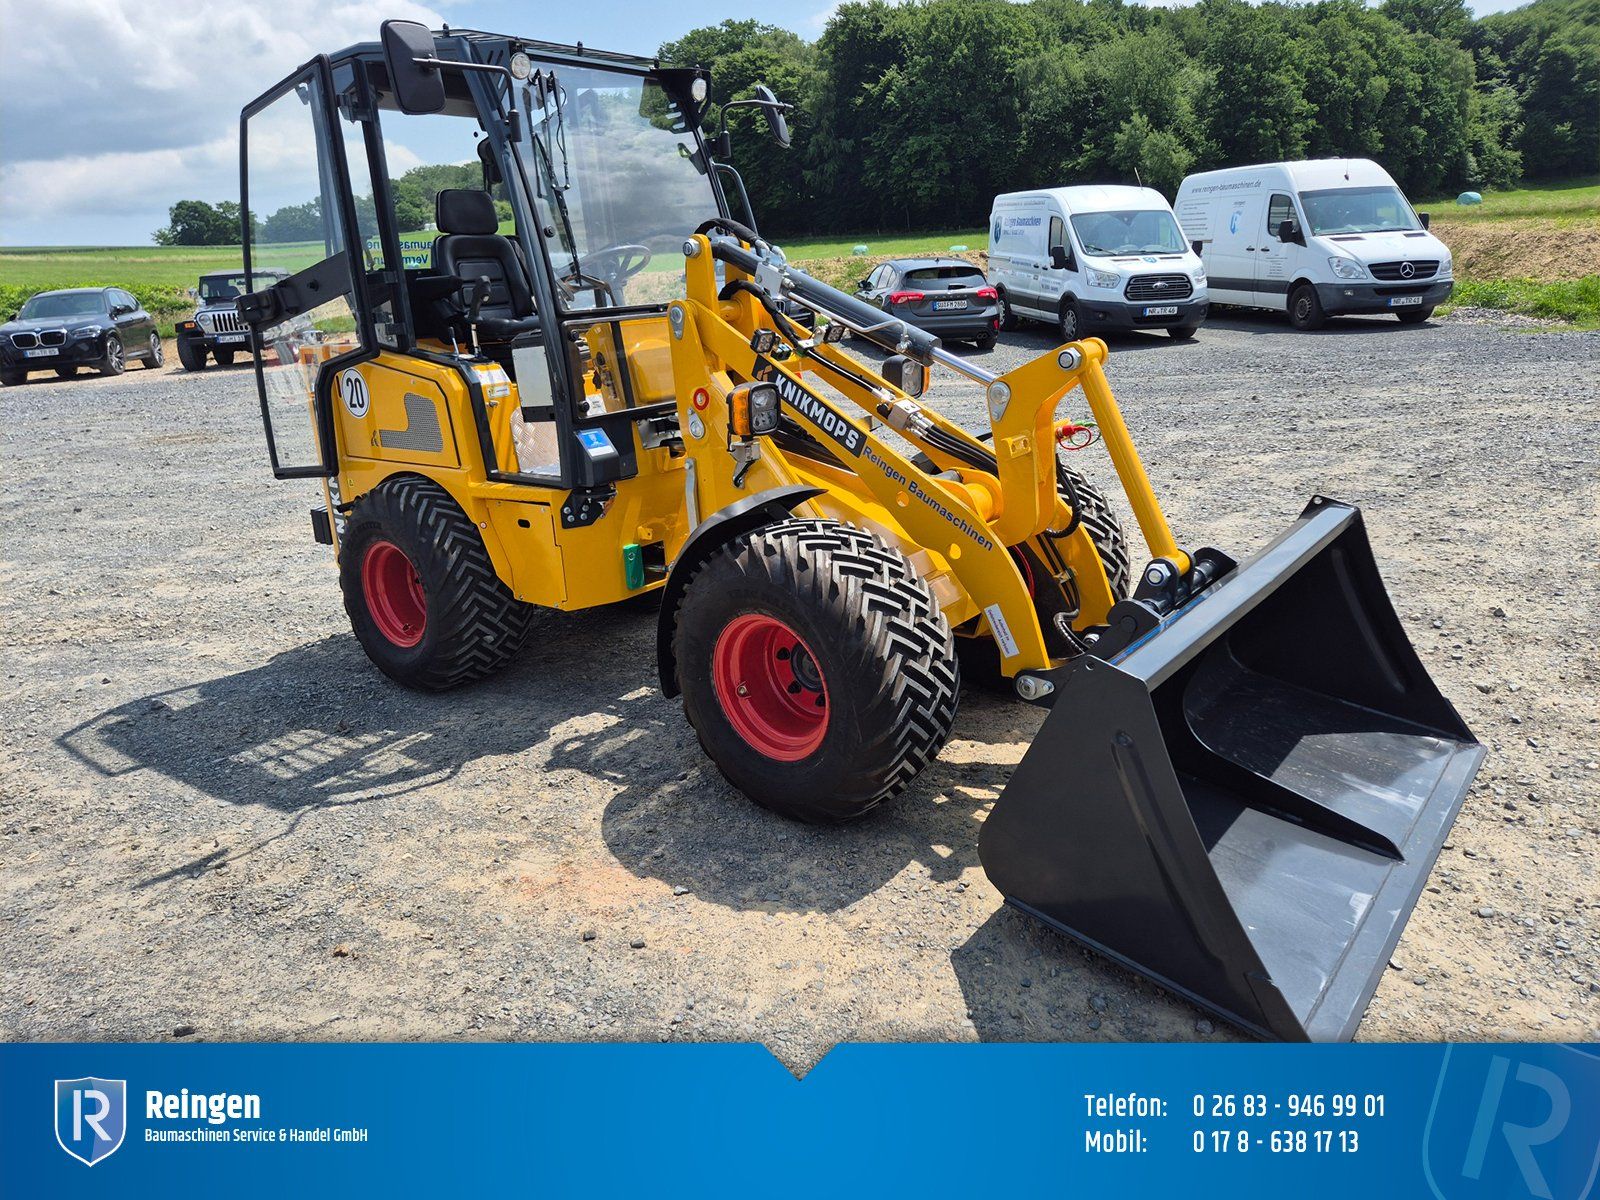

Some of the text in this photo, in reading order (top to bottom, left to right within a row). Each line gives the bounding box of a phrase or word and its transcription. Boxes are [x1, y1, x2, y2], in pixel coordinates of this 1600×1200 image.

[346, 377, 365, 408] 20
[775, 373, 860, 450] KNIKMOPS
[863, 445, 994, 552] Reingen Baumaschinen
